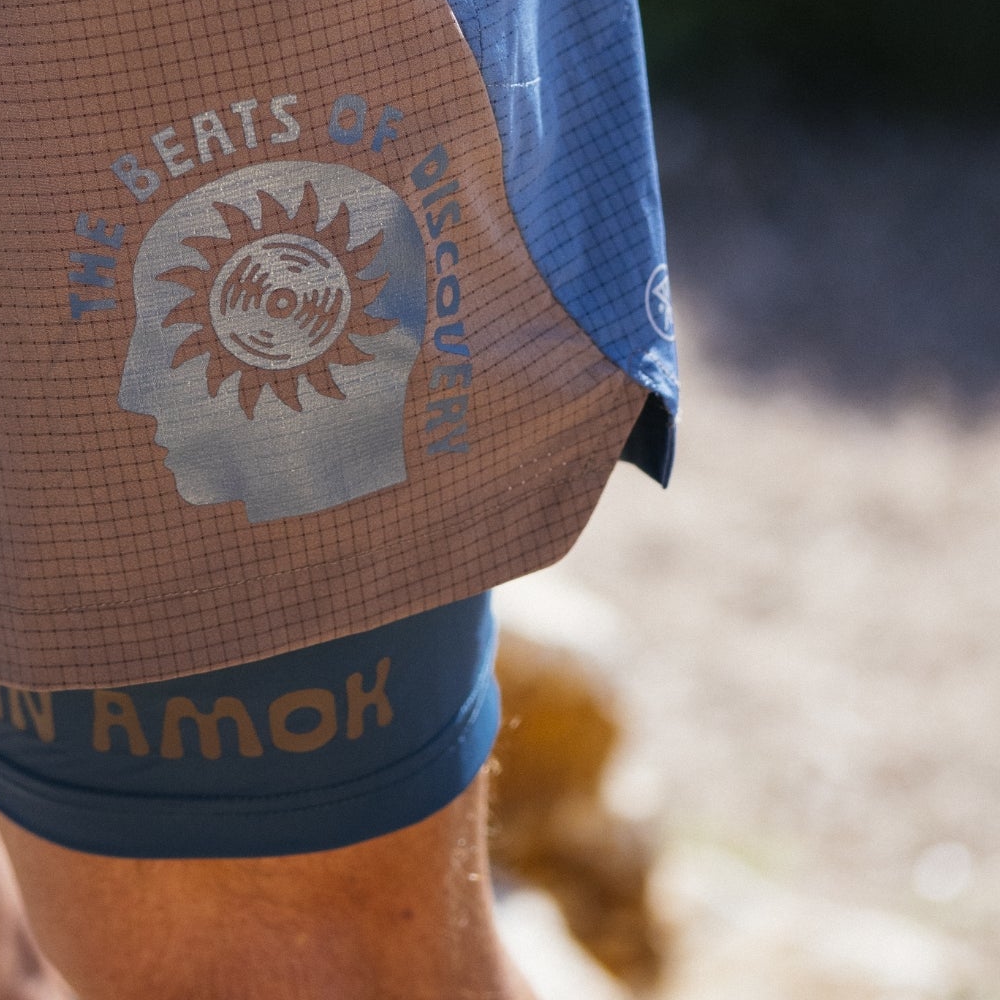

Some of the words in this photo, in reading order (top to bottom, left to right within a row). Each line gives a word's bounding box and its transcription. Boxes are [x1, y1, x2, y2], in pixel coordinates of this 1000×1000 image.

[67, 211, 126, 319] THE
[110, 93, 301, 201] BEATS
[329, 93, 404, 153] OF
[410, 142, 474, 456] DISCOVERY
[92, 656, 394, 760] AMOK
